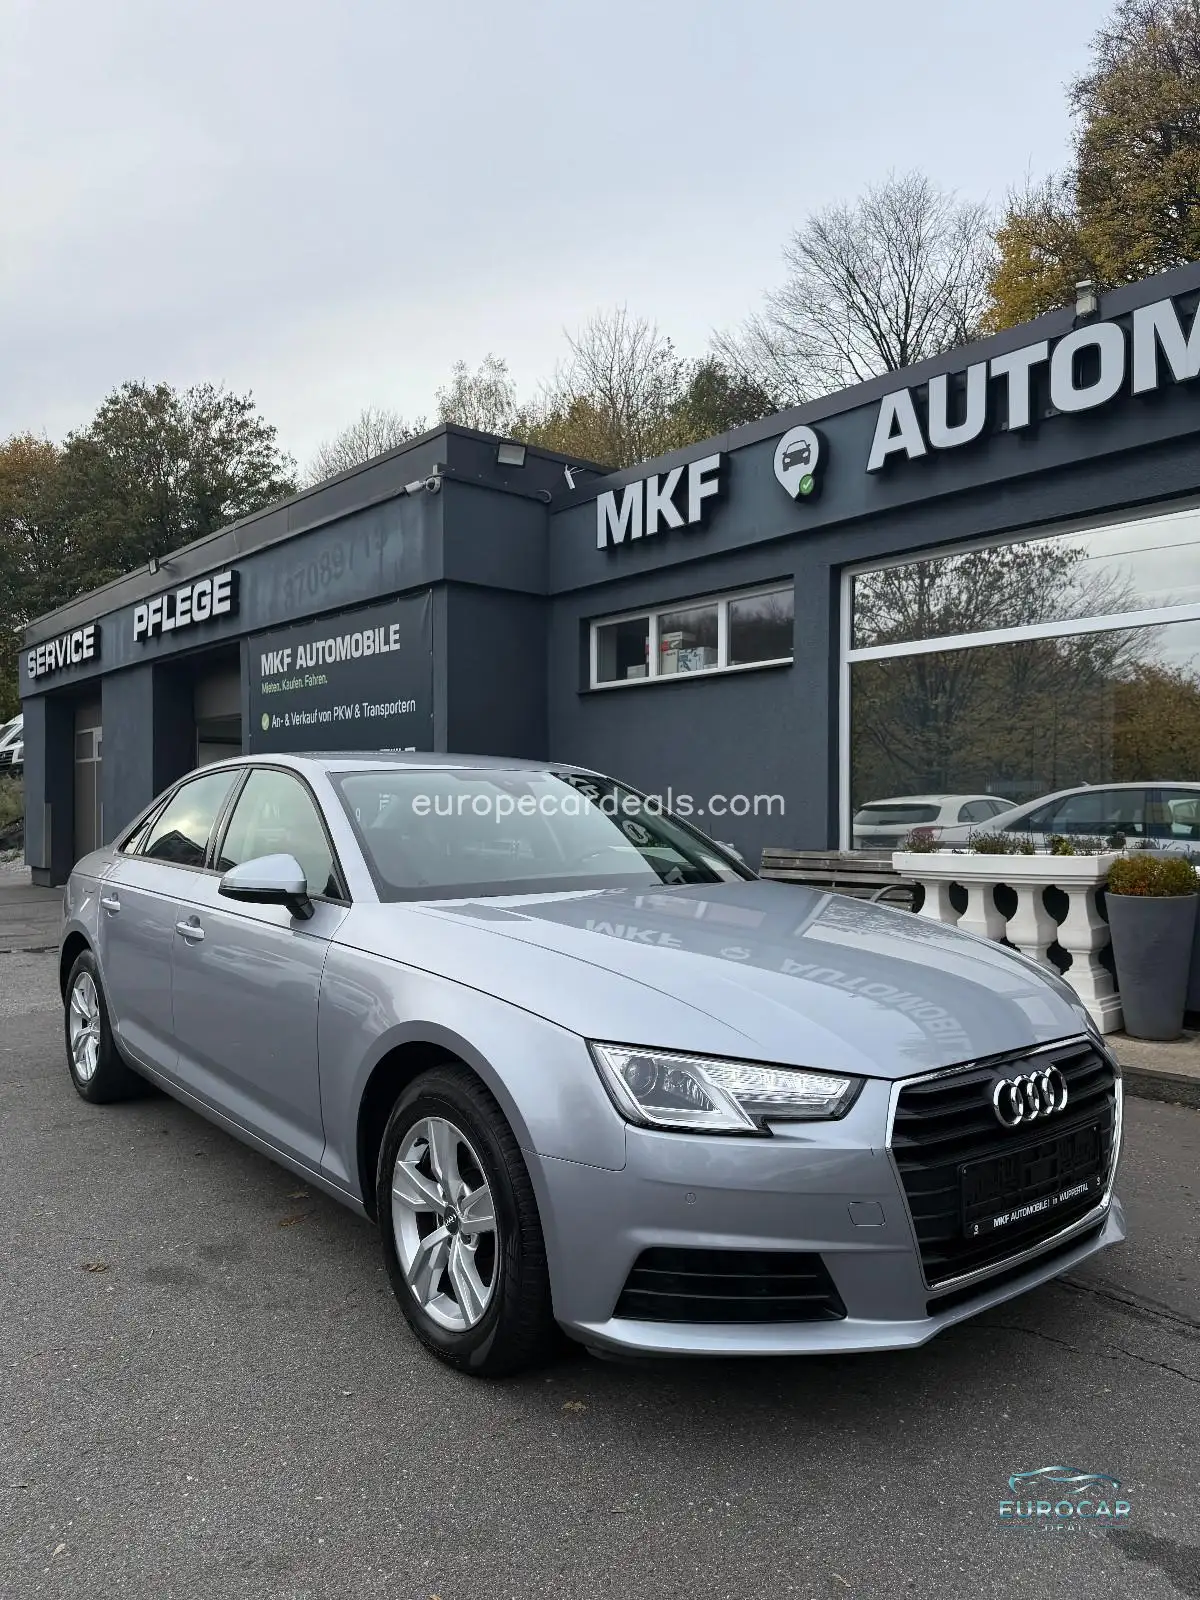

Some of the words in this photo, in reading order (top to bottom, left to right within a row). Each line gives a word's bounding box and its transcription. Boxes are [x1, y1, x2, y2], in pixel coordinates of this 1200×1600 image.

[596, 453, 721, 550] MKF
[133, 571, 233, 642] PFLEGE
[27, 625, 95, 679] SERVICE
[261, 648, 292, 677] MKF
[296, 623, 401, 670] AUTOMOBILE
[271, 714, 284, 728] An-
[284, 713, 290, 726] &
[290, 709, 319, 726] Verkauf
[319, 710, 332, 723] von
[333, 705, 353, 721] PKW
[354, 705, 361, 719] &
[362, 699, 416, 718] Transportern
[993, 1214, 1010, 1228] MKF
[1059, 1183, 1089, 1202] WUPPERTAL
